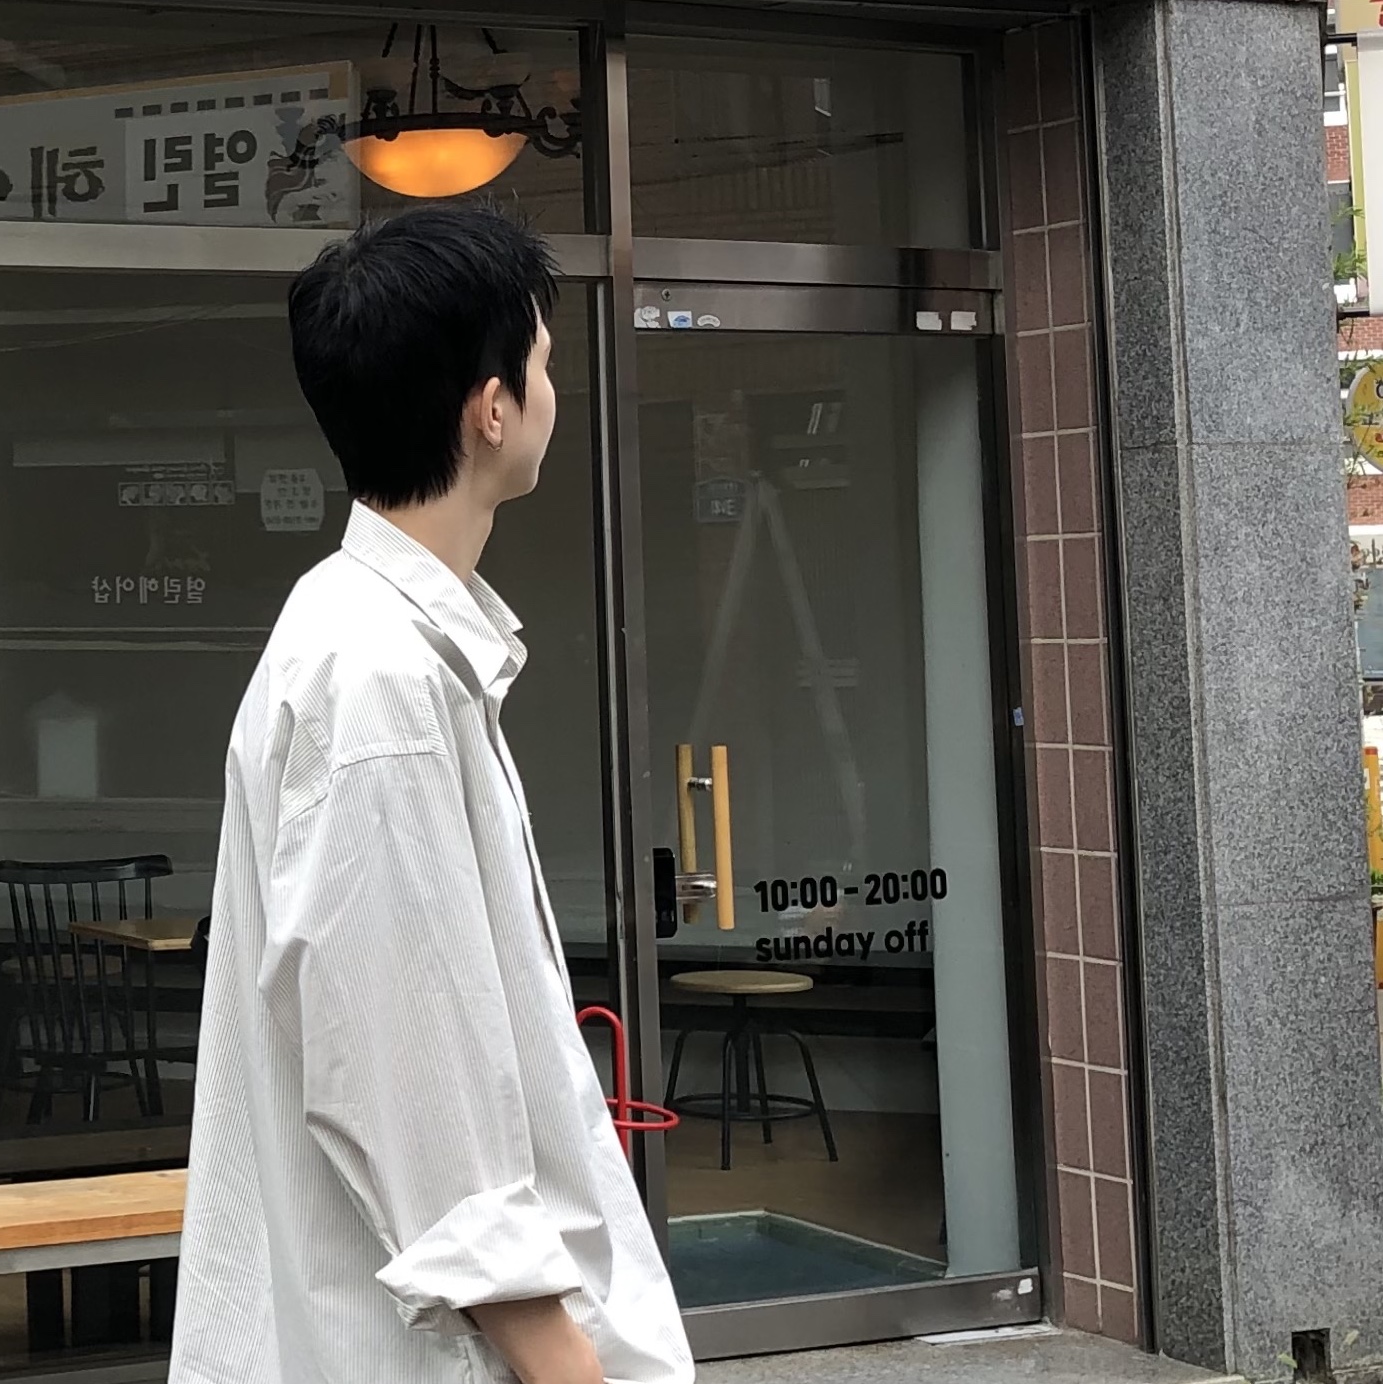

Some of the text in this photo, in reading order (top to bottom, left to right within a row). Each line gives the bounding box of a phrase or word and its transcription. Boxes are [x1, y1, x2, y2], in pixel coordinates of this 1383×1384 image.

[754, 876, 838, 912] 10:00
[864, 868, 947, 905] 20:00
[755, 920, 929, 962] sunday off
